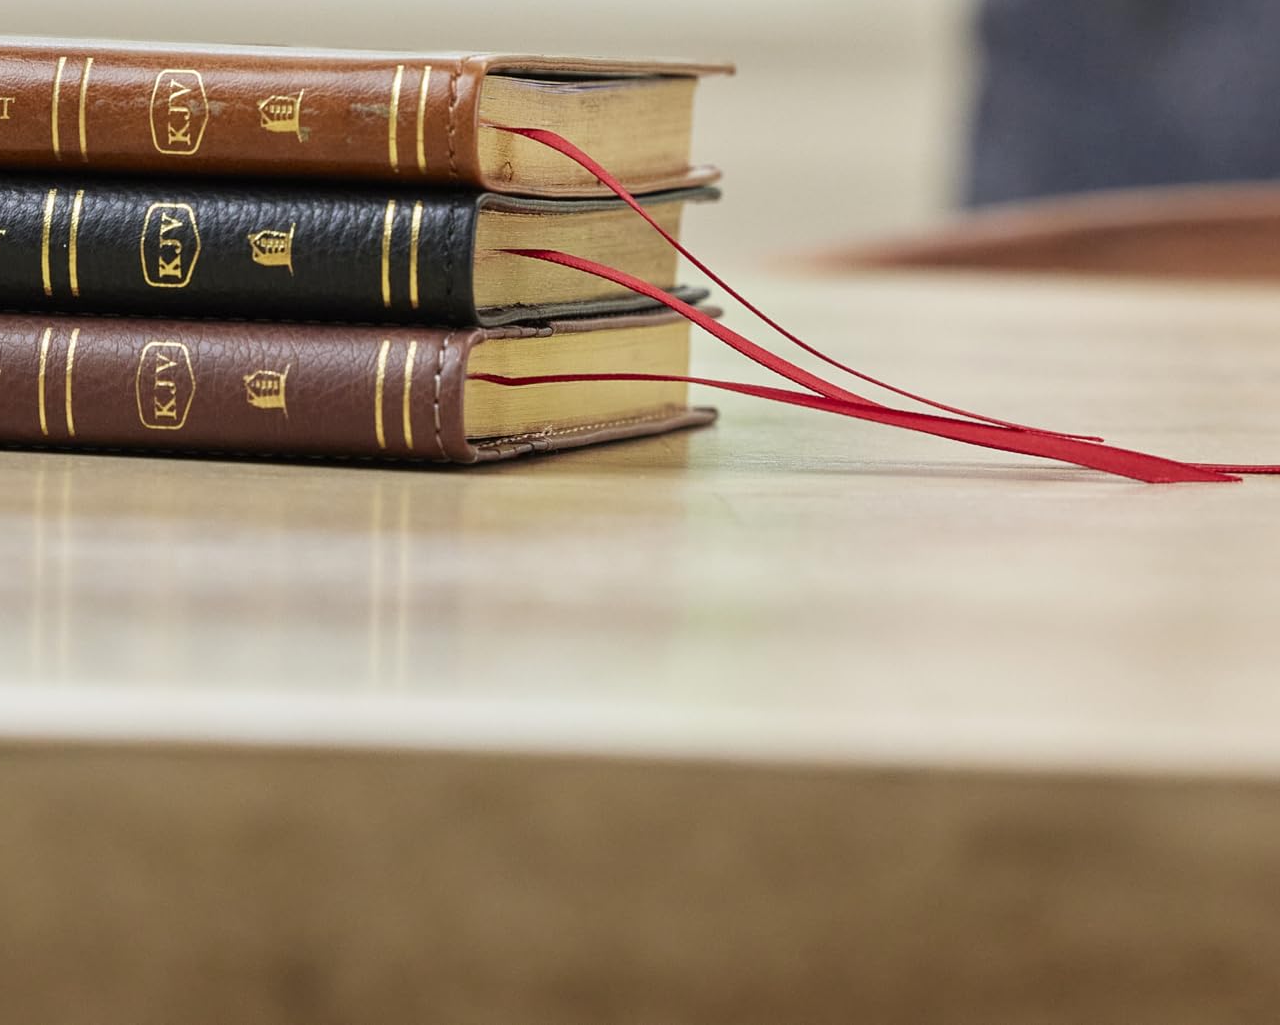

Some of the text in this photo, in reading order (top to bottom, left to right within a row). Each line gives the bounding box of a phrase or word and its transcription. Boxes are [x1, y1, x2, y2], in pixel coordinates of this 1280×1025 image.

[167, 78, 195, 145] KJV
[158, 212, 185, 279] KJV
[154, 351, 179, 420] KJV
